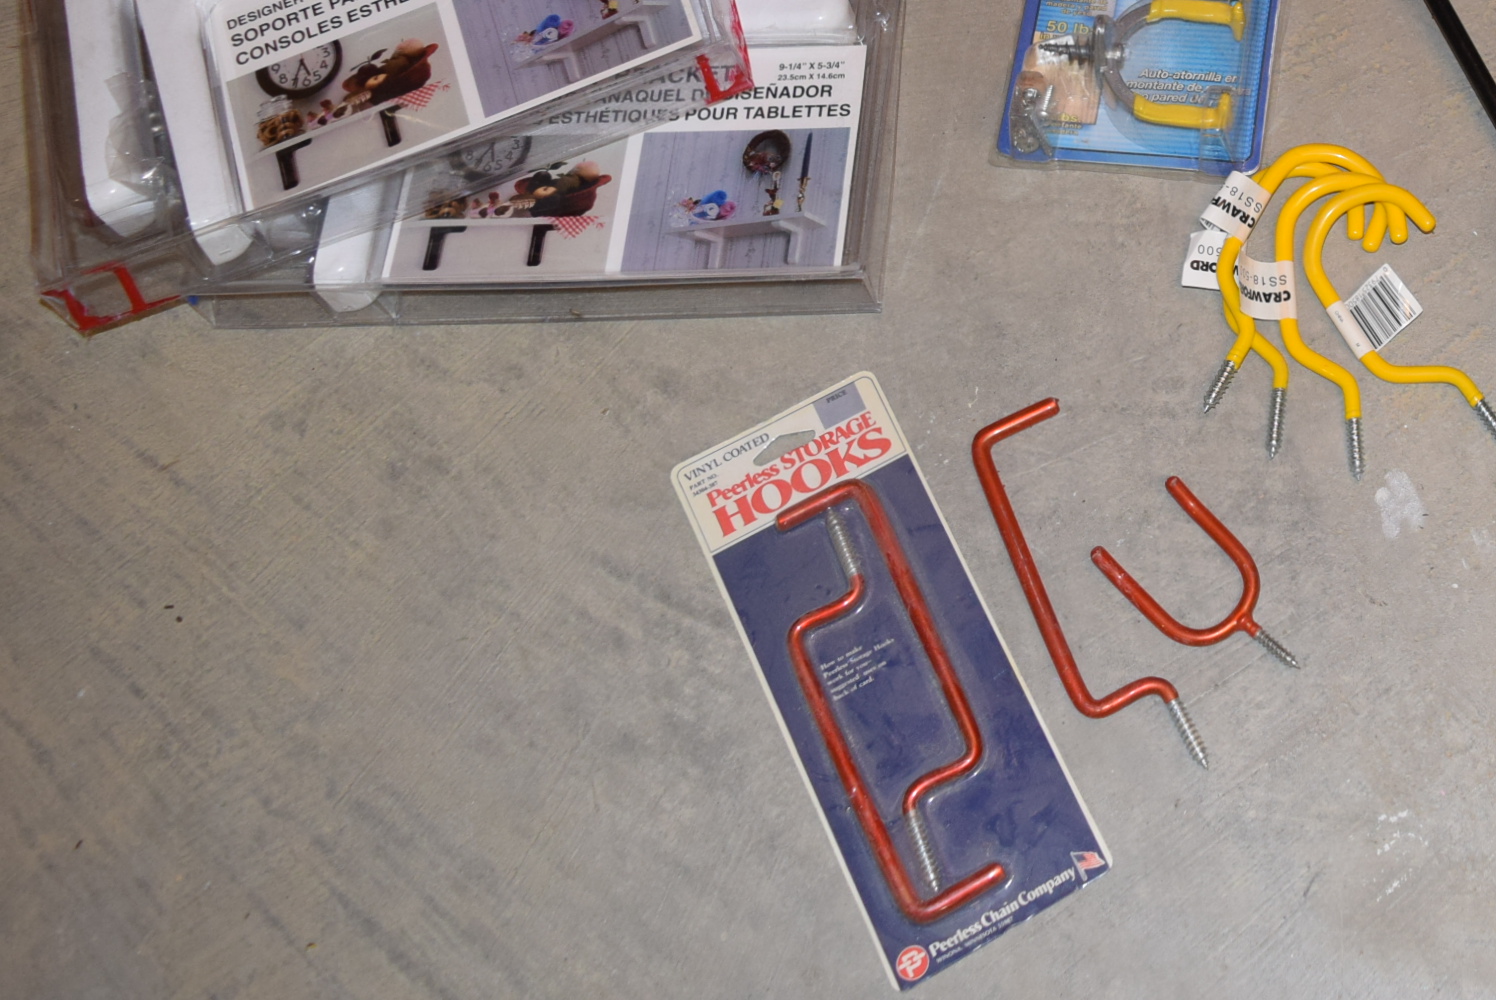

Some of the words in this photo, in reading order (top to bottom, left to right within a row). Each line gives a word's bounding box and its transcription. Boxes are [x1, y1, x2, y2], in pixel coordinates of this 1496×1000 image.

[230, 2, 325, 47] SOPORTE
[1047, 20, 1068, 33] 50
[236, 15, 343, 66] CONSOLES
[1126, 80, 1184, 91] montante
[1186, 83, 1203, 92] de
[1138, 68, 1222, 82] Auto-atornilla
[685, 107, 738, 121] POUR
[744, 103, 851, 120] TABLETTES
[1150, 92, 1188, 103] pared
[826, 389, 847, 403] PRICE
[684, 457, 722, 482] VINYL
[723, 432, 770, 462] COATED
[706, 464, 780, 508] Peerless
[780, 411, 877, 470] STORAGE
[712, 427, 892, 538] HOOKS
[928, 922, 983, 958] Peerless
[980, 900, 1020, 927] Chain
[1018, 866, 1078, 907] Company
